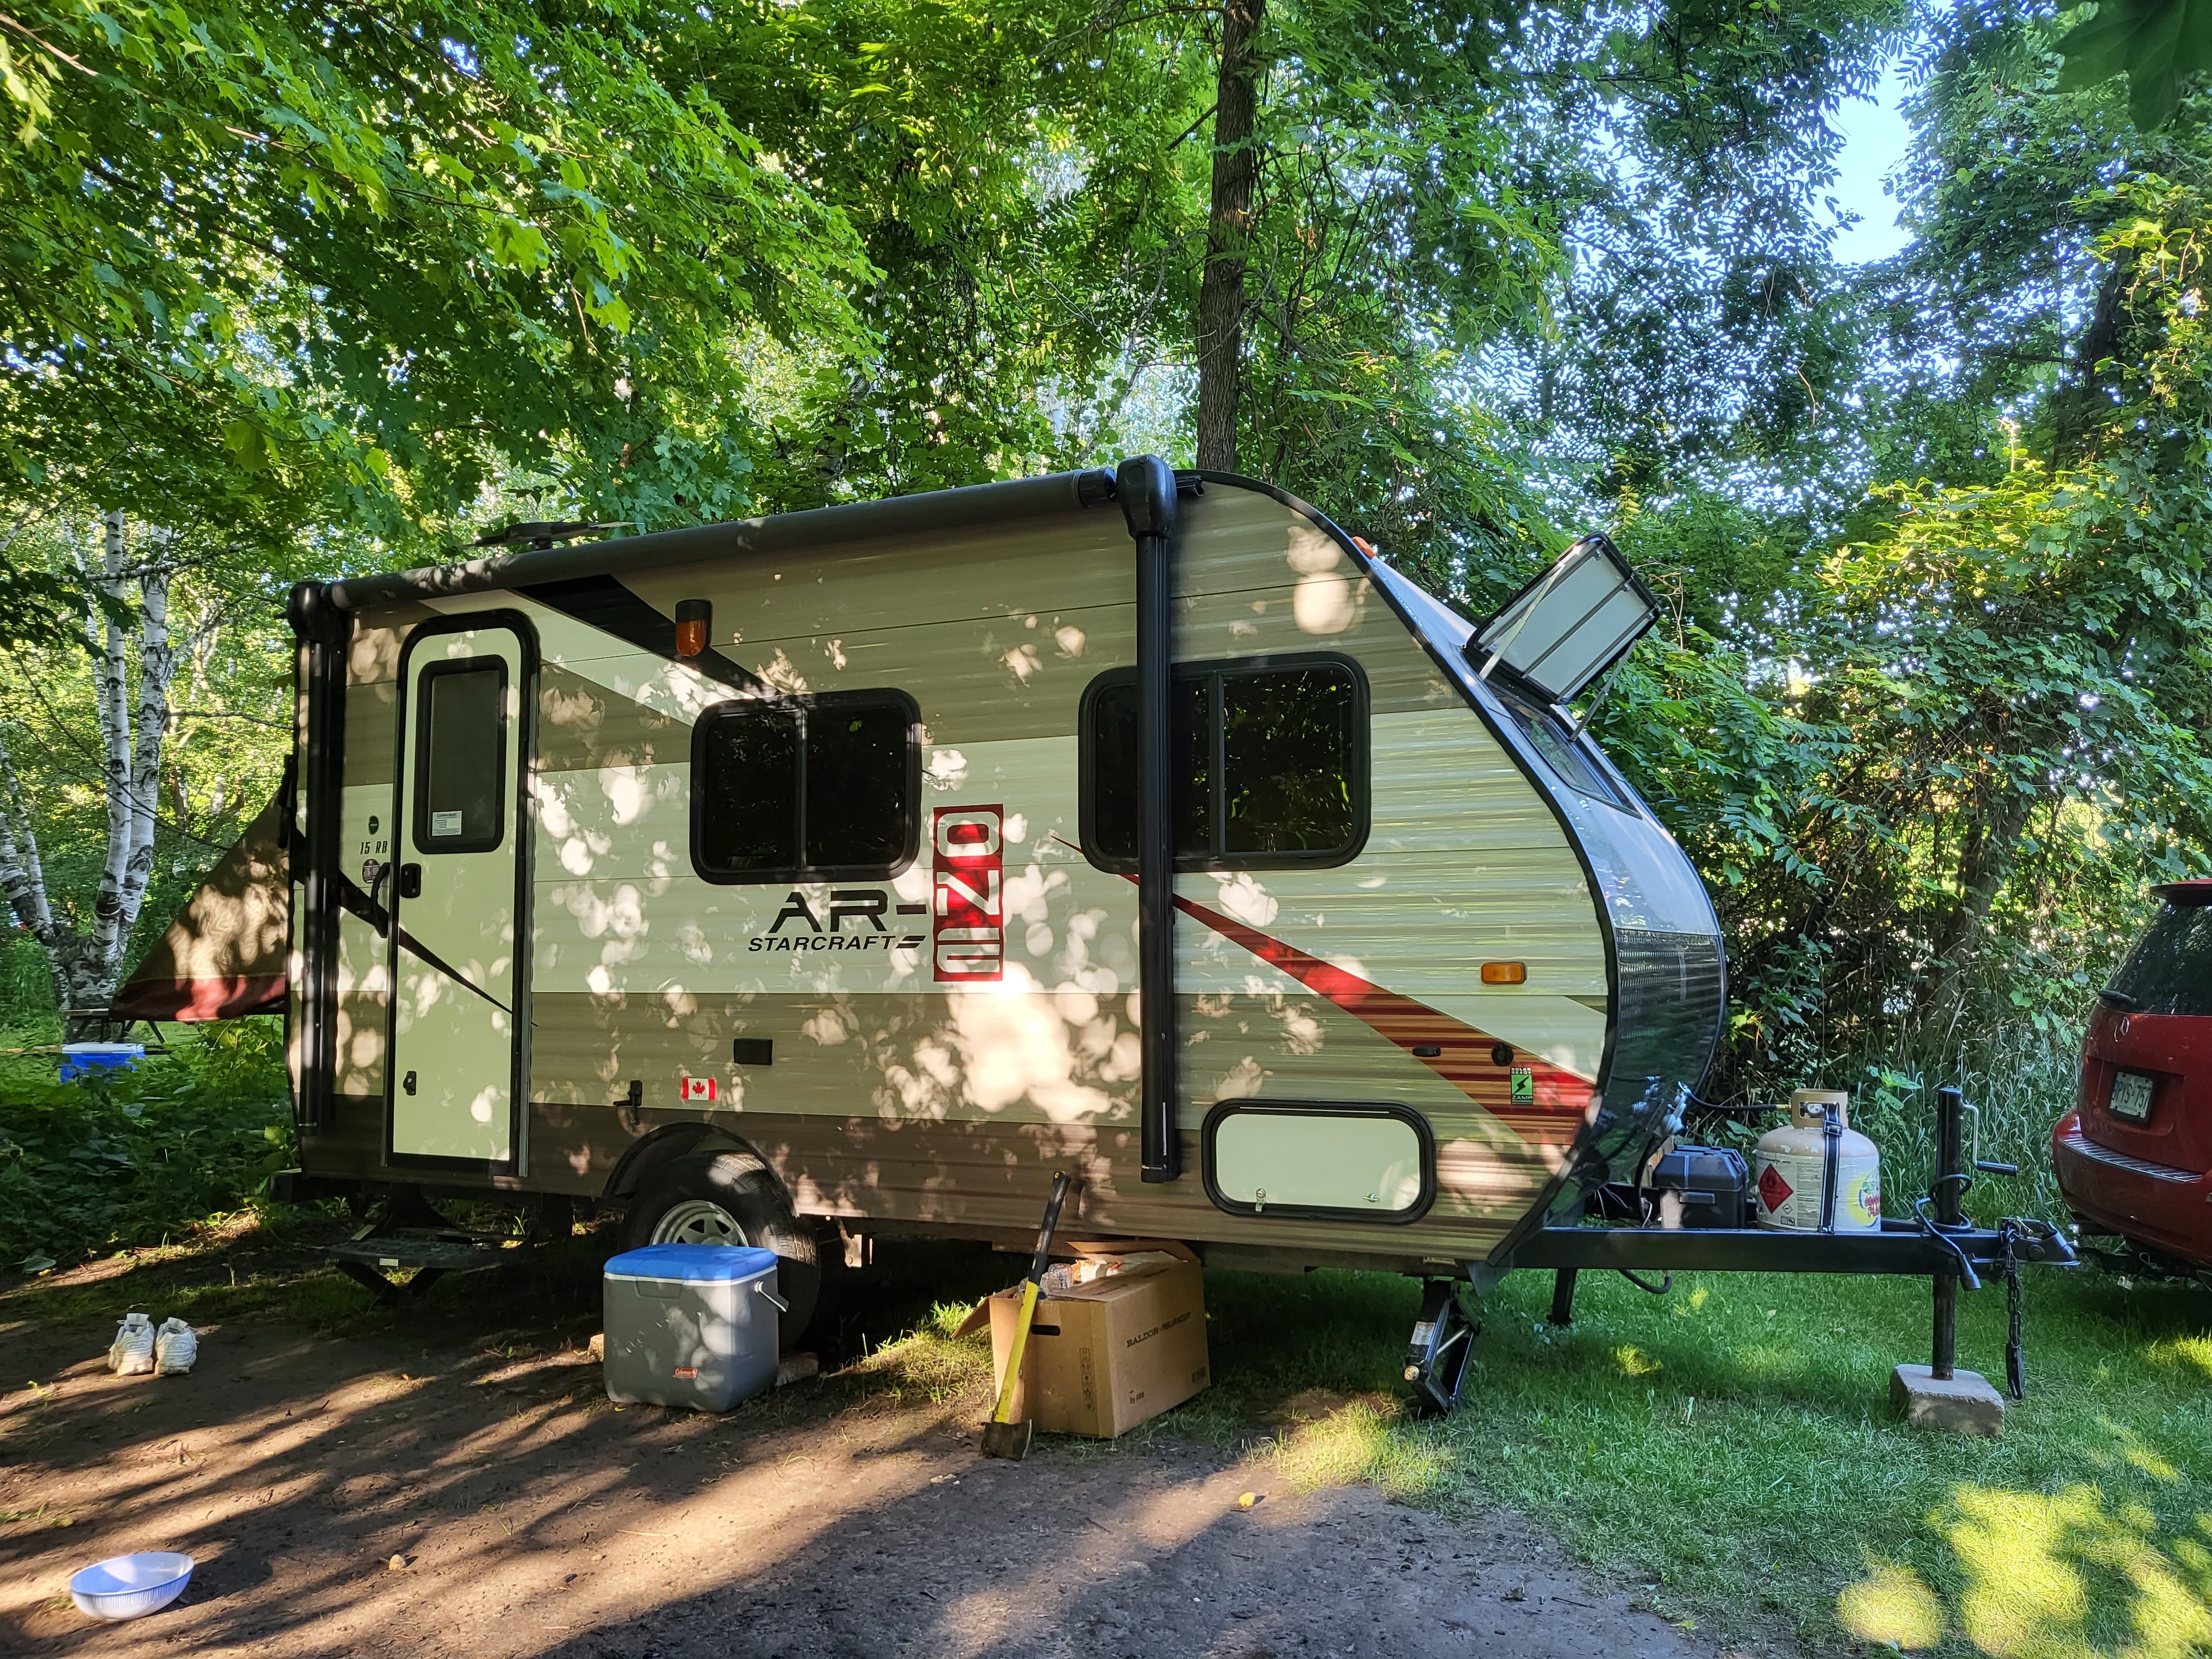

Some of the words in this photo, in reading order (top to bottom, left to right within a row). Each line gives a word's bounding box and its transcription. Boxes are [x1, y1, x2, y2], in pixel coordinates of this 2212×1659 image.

[360, 842, 371, 855] 15
[375, 841, 388, 854] RB
[748, 935, 896, 952] STARCRAFT
[1126, 1327, 1159, 1348] BALDOR
